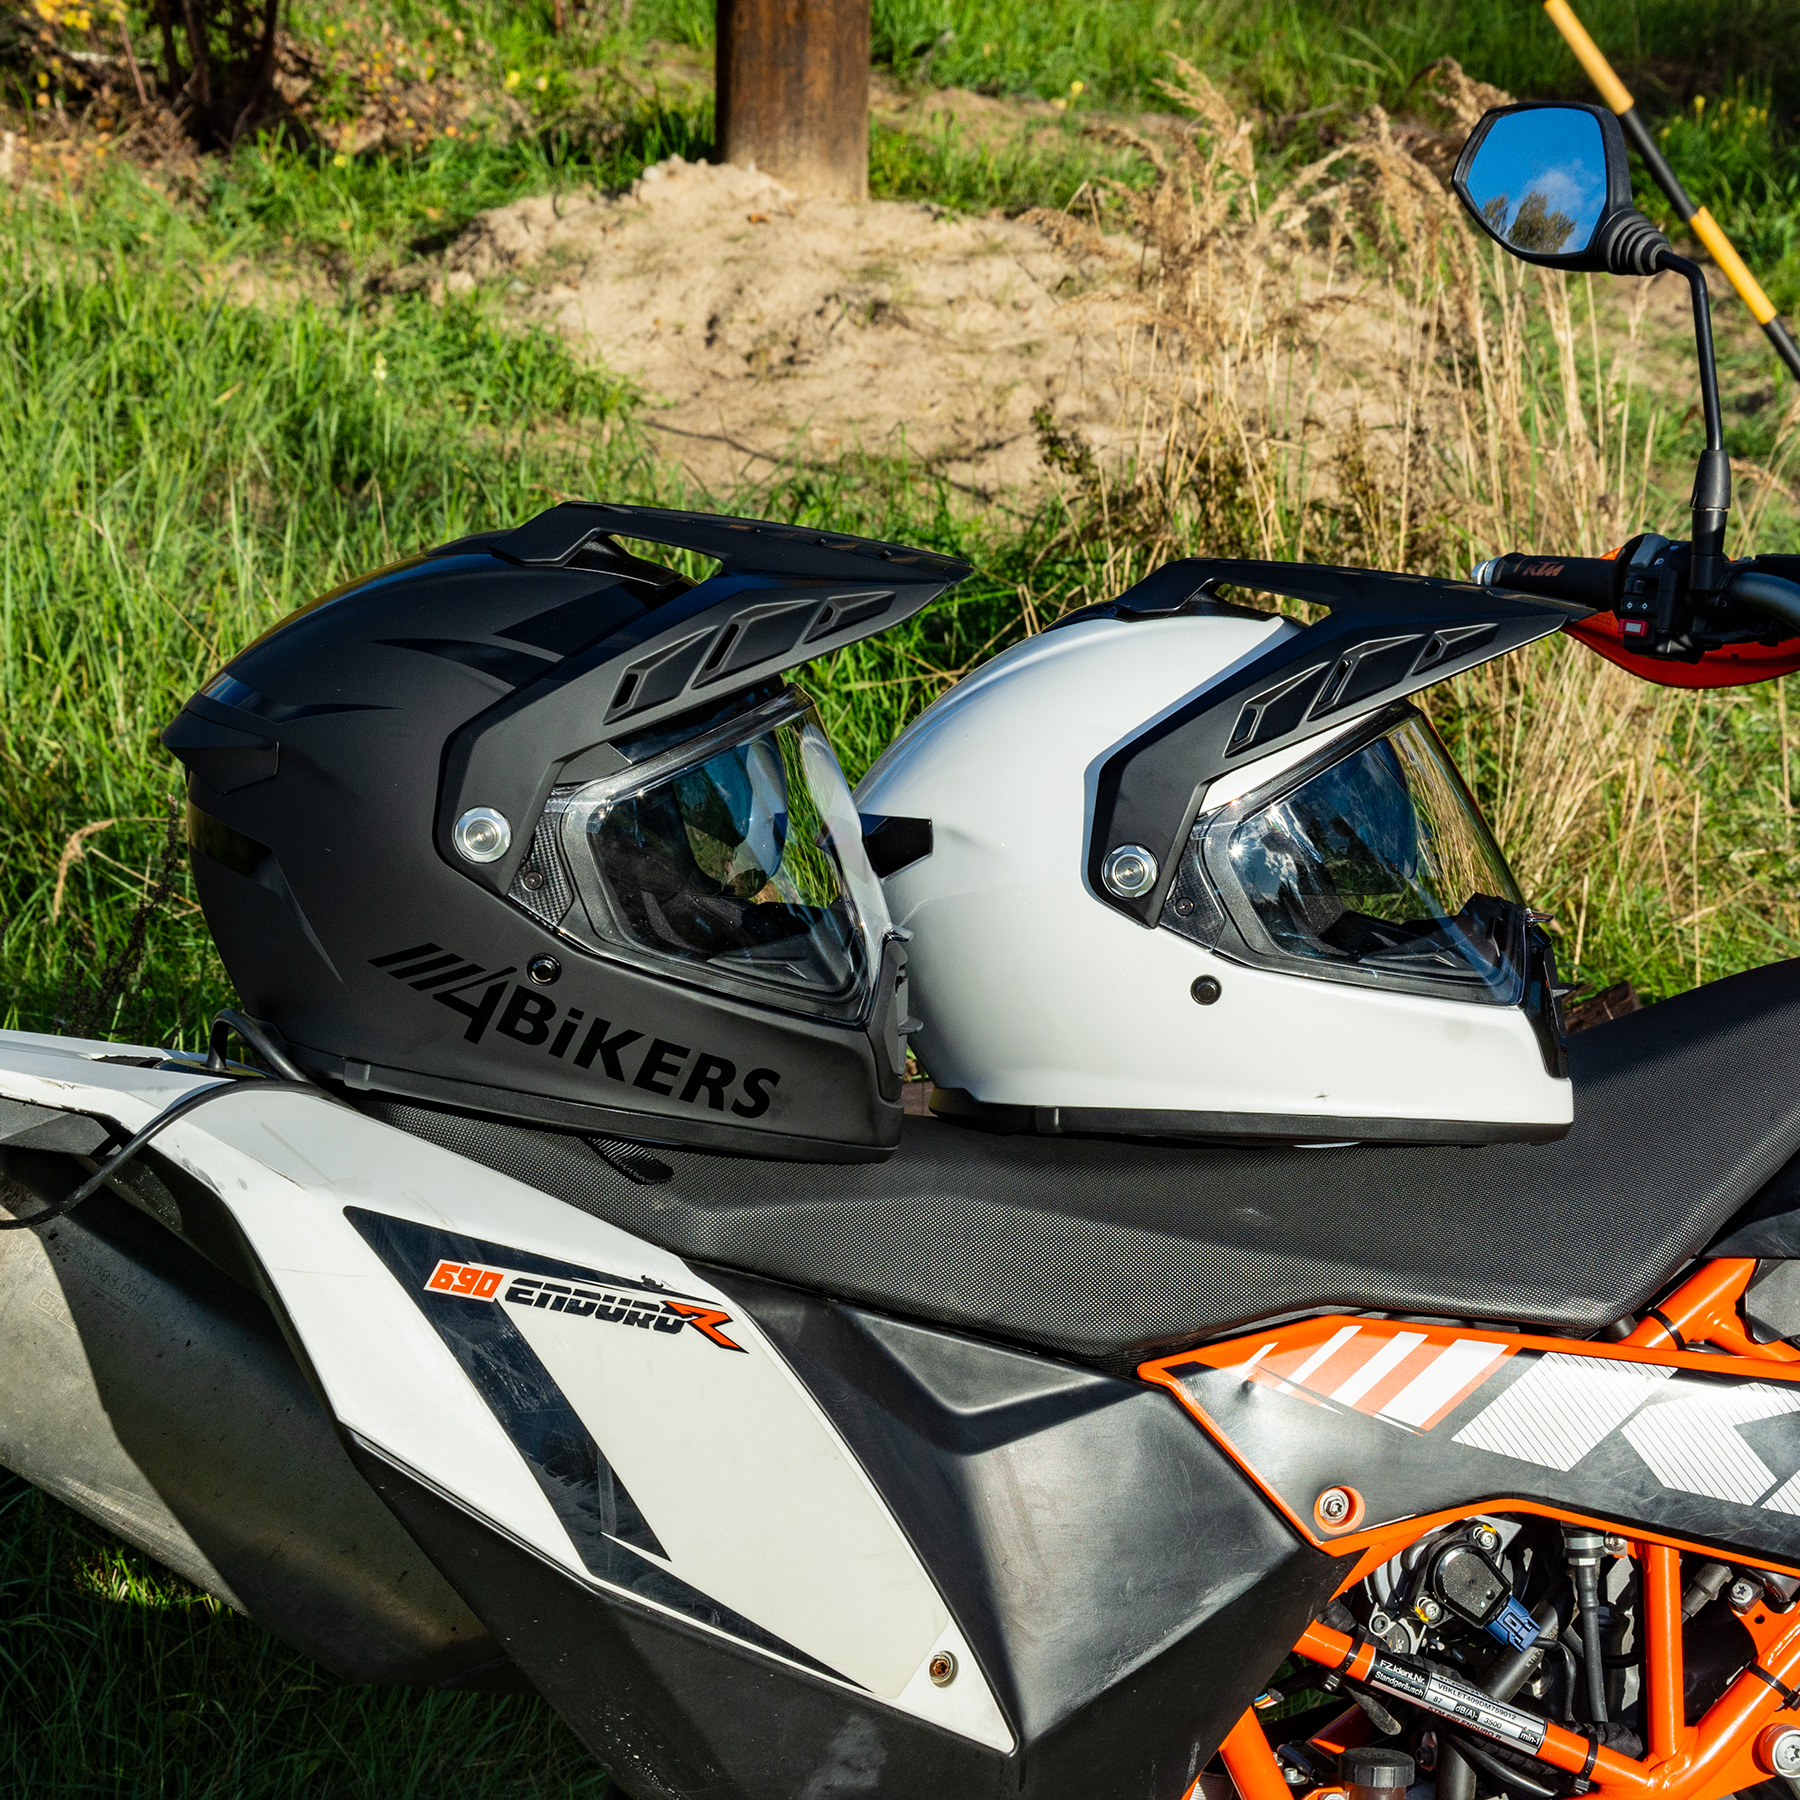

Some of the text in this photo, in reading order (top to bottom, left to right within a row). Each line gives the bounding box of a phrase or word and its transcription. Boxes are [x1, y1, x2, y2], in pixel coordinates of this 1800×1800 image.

[1522, 561, 1565, 577] KTM
[427, 1261, 750, 1355] 690 ENDURO R
[1374, 1671, 1425, 1698] Standgeräusch
[1432, 1695, 1443, 1704] 87
[1483, 1717, 1503, 1730] 3500
